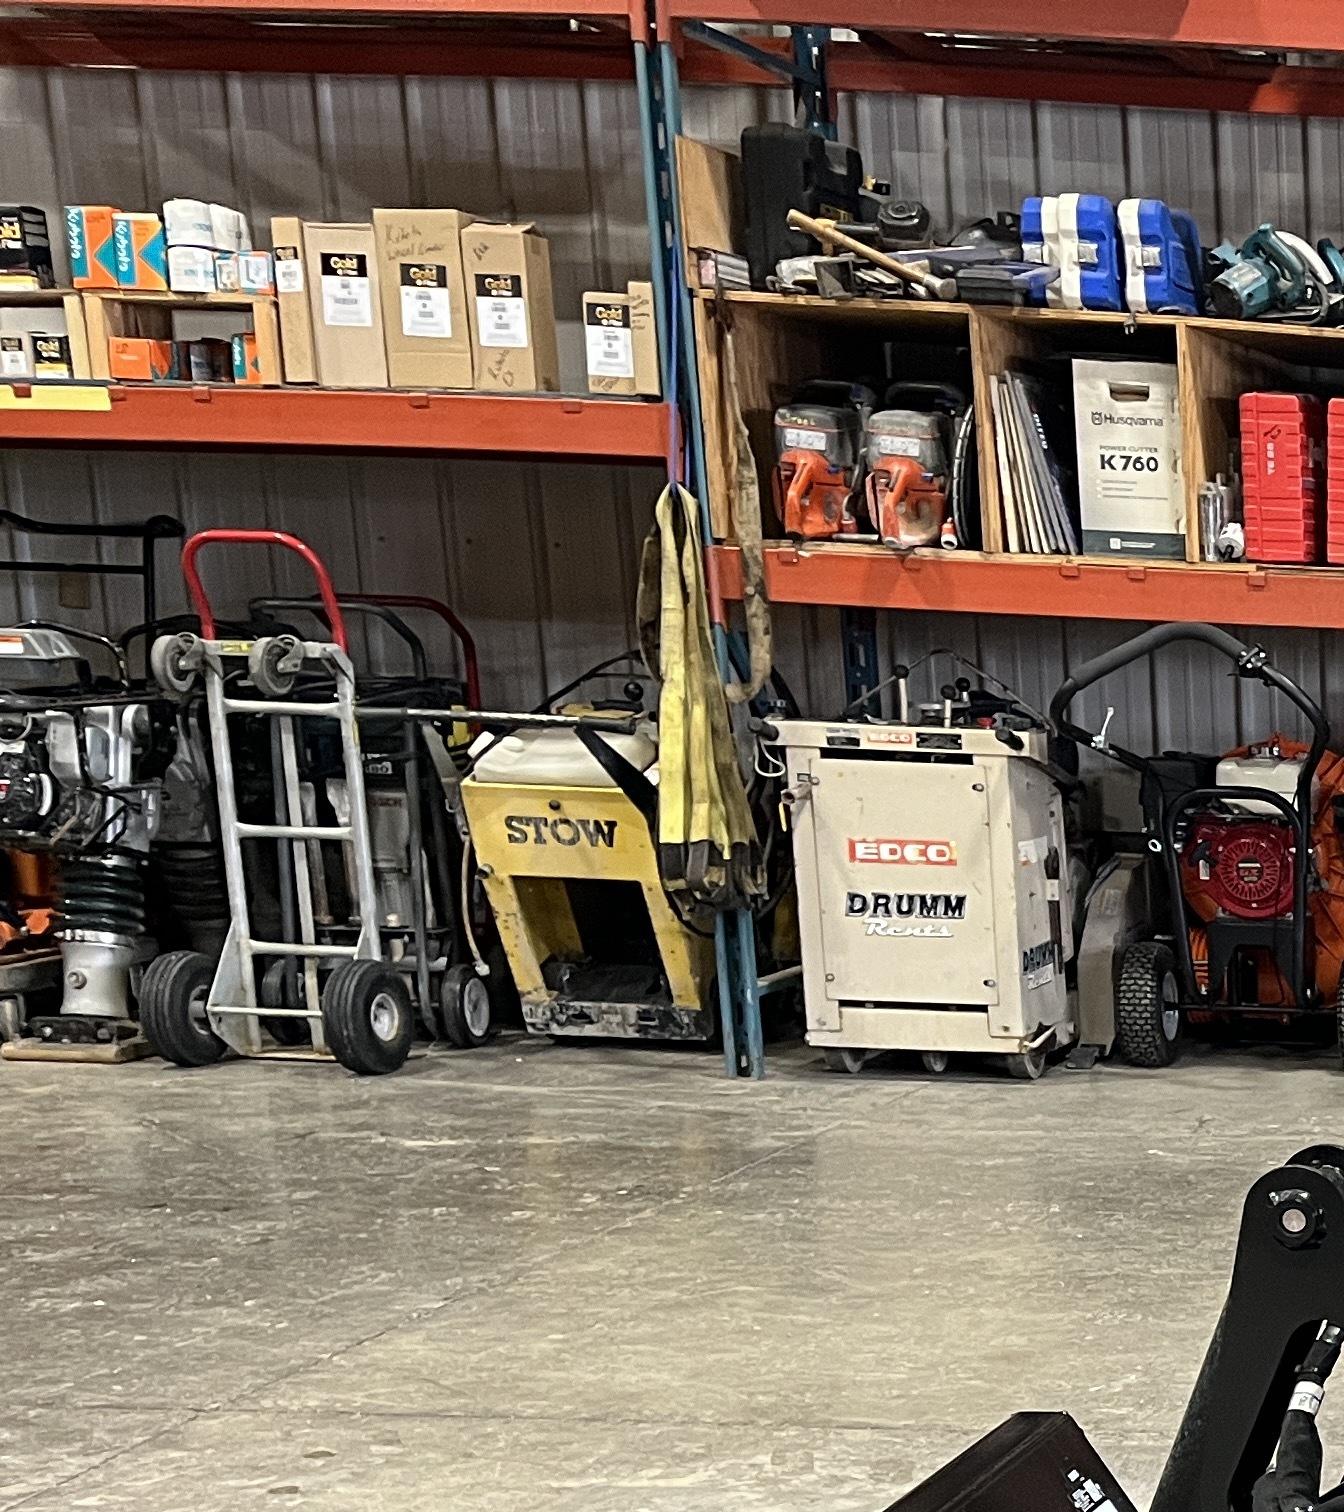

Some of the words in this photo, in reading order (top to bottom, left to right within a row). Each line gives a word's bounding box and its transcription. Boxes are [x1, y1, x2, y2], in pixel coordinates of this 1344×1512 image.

[66, 206, 81, 260] Kubota
[116, 219, 129, 273] Kubota
[329, 255, 359, 271] Gold
[408, 266, 438, 282] Gold
[484, 276, 512, 292] Gold
[594, 305, 623, 321] Gold
[1103, 412, 1164, 428] Husqvarna
[1100, 444, 1127, 452] POWER
[1128, 446, 1158, 454] CUTTER
[504, 815, 618, 848] STOW
[854, 841, 952, 863] EDCO
[845, 891, 968, 920] DRUMM
[863, 917, 955, 938] Rents
